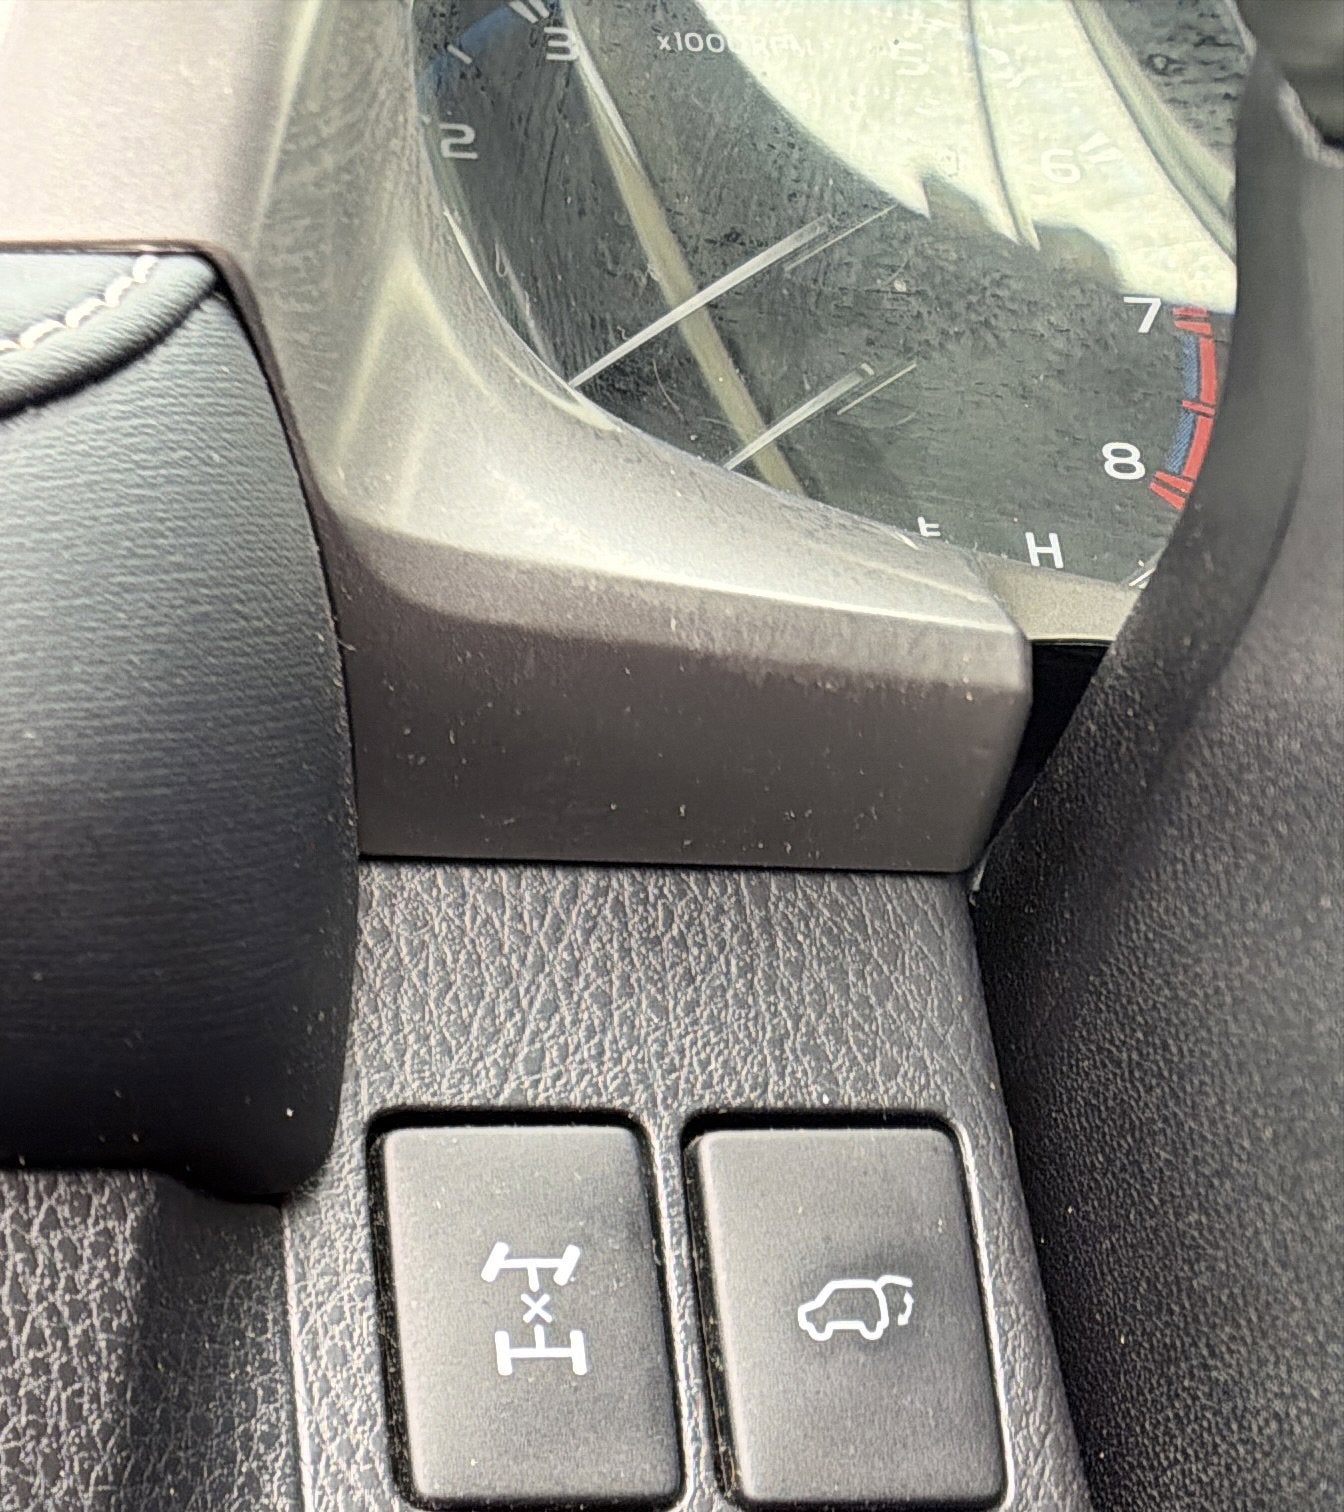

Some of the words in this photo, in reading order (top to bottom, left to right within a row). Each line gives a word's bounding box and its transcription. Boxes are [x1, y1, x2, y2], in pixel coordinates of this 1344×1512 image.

[543, 26, 579, 61] 3
[438, 123, 479, 160] 2
[1040, 148, 1081, 184] 6
[1123, 296, 1162, 334] 7
[1101, 441, 1146, 481] 8
[1024, 531, 1064, 569] H
